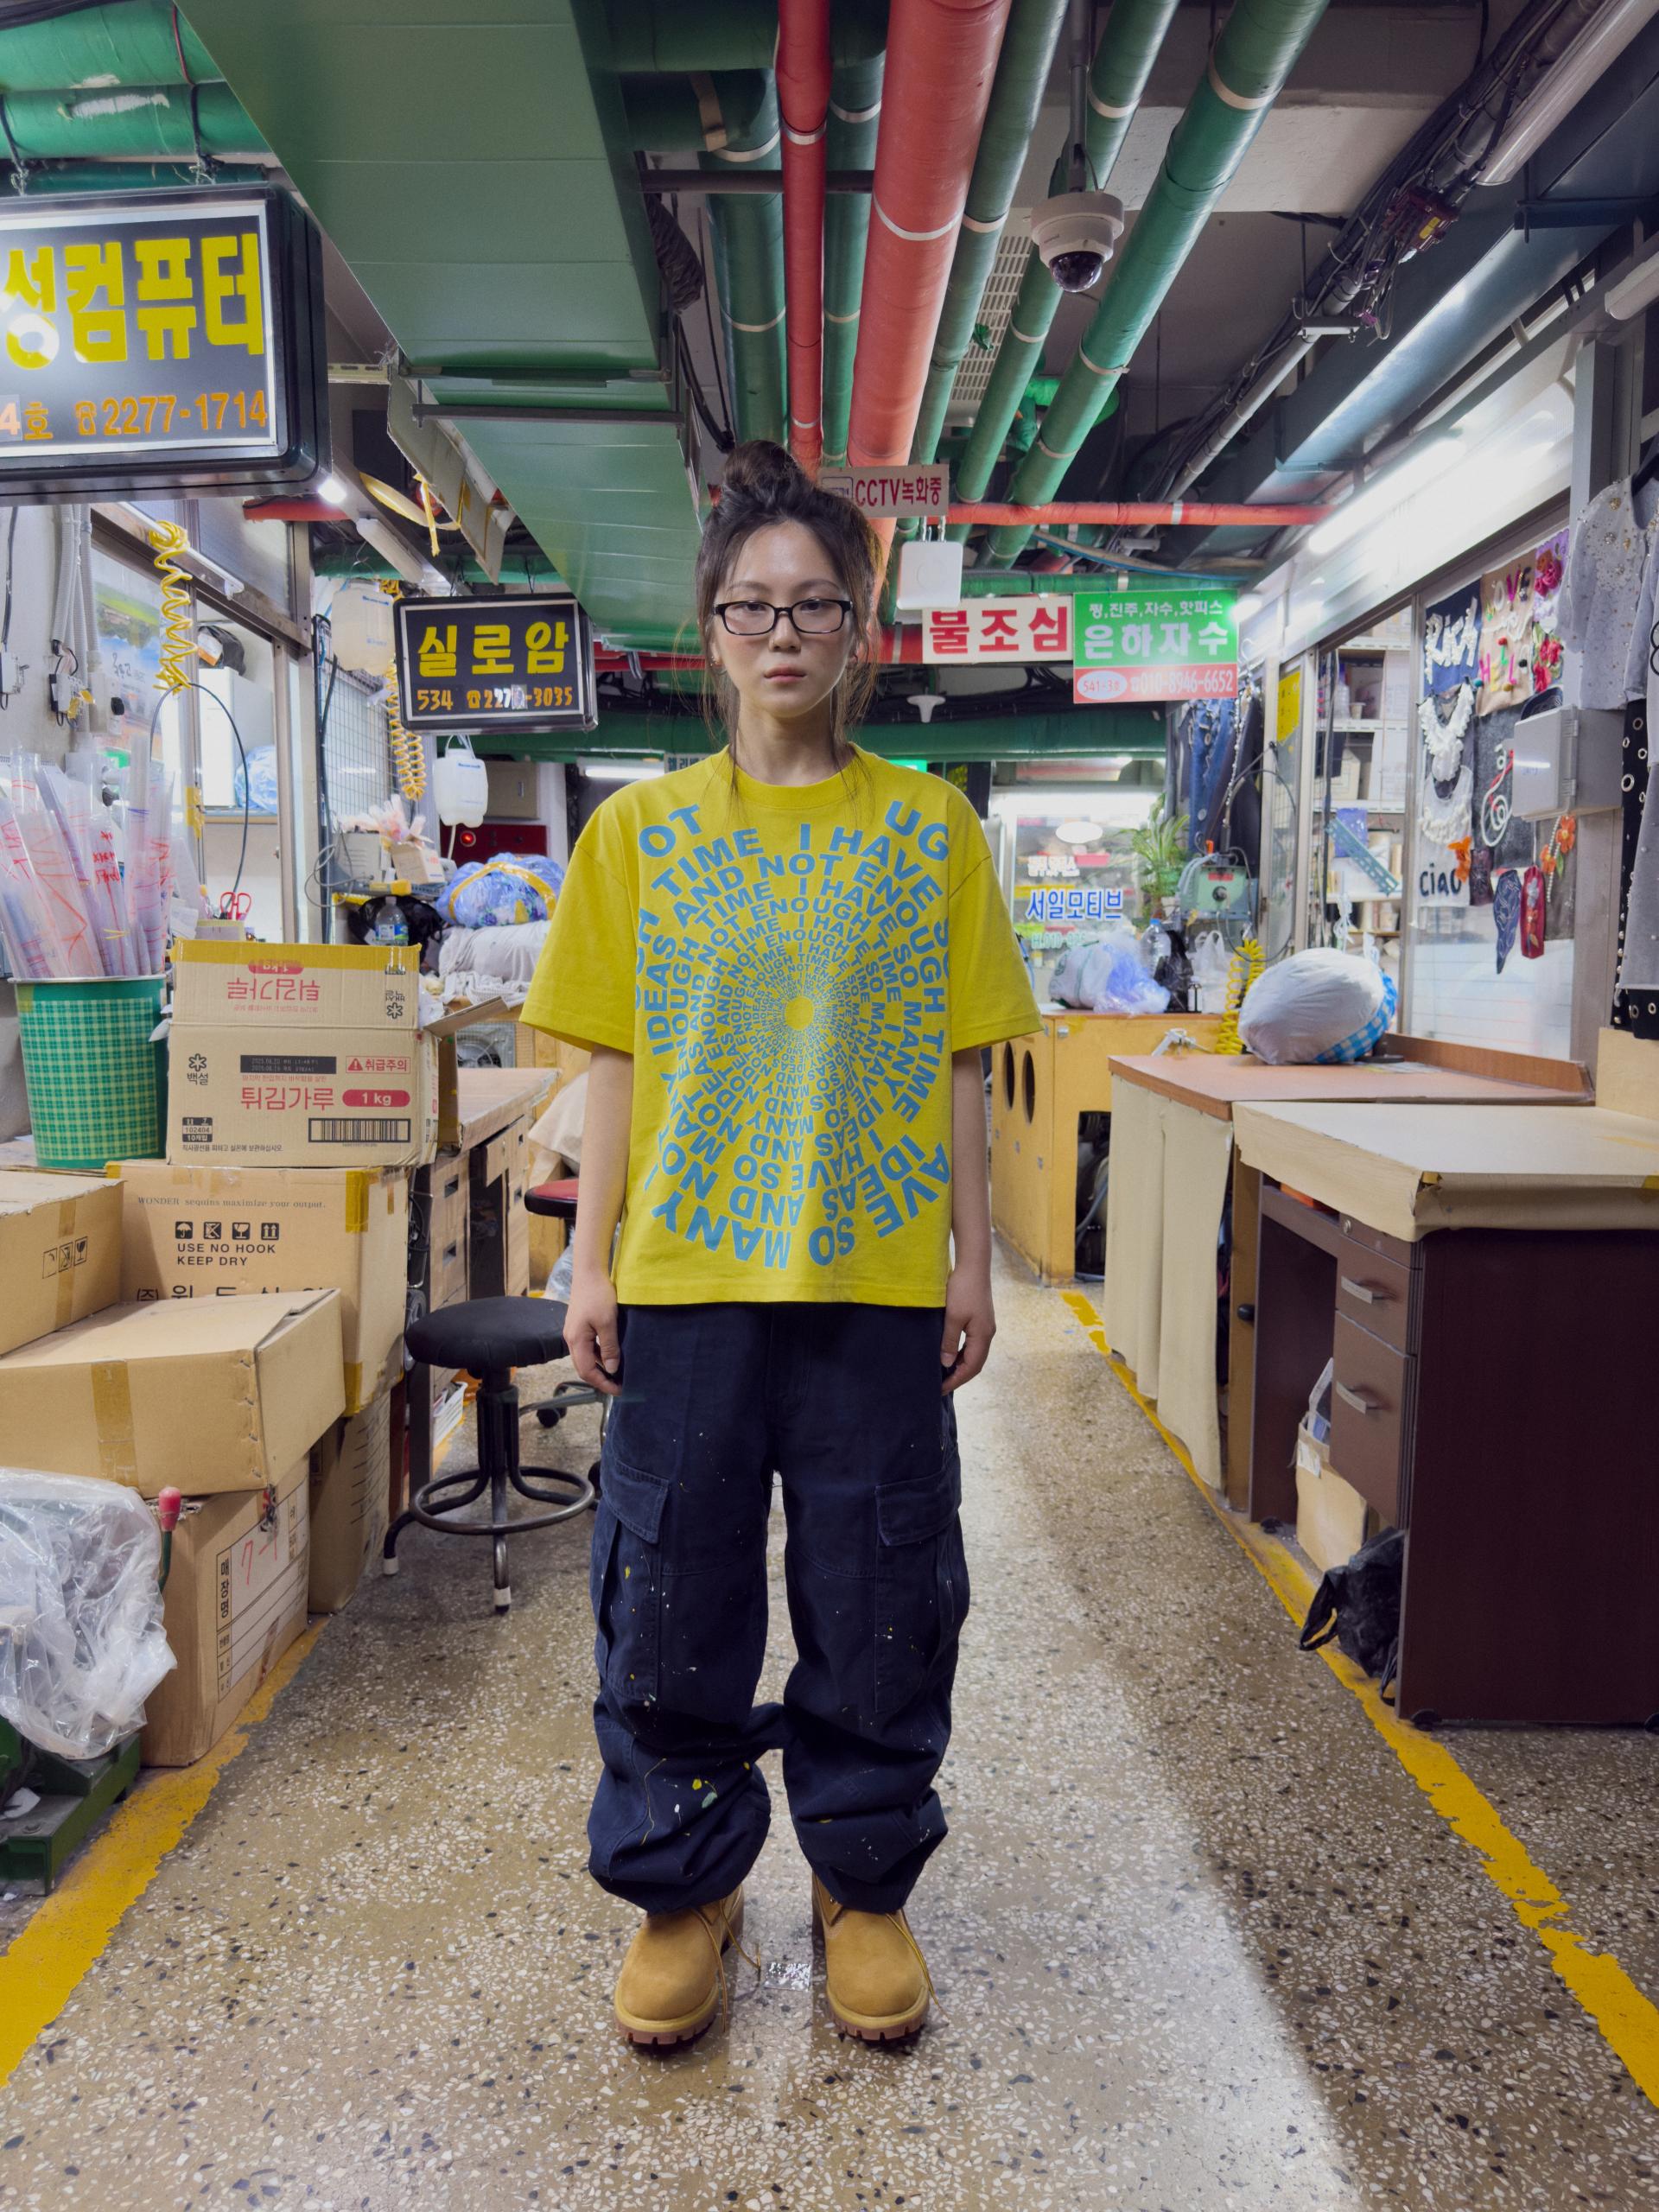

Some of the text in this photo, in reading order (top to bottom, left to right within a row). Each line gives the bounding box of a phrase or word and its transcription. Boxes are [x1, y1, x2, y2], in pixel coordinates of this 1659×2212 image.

[418, 621, 569, 677] 실로암
[929, 606, 1068, 654] 불조심
[1084, 621, 1229, 660] 은하자수
[417, 690, 453, 710] 534
[652, 829, 763, 896] TIME
[758, 854, 843, 878] NOT
[830, 827, 942, 911] HAVE
[673, 867, 744, 927] AND
[695, 881, 774, 929] TIME
[750, 897, 871, 932] ENOUGH
[820, 875, 899, 938] HAVE
[1027, 889, 1122, 919] 서일모티브
[698, 915, 741, 965] NOT
[725, 918, 781, 953] TIME
[814, 915, 874, 957] HAVE
[853, 861, 945, 1013] ENOUGH
[227, 977, 321, 1001] 튀김가루
[863, 961, 883, 993] SO
[873, 933, 901, 1001] TIME
[890, 944, 918, 988] SO
[645, 935, 678, 1055] IDEAS
[671, 937, 703, 1080] ENOUGH
[700, 957, 728, 1060] ENOUGH
[860, 1002, 885, 1070] MANY
[883, 1001, 921, 1097] MANY
[187, 1072, 209, 1086] 백설
[365, 1057, 408, 1071] 취급주의
[684, 1042, 743, 1116] IDEAS
[717, 1067, 760, 1103] NOT
[850, 1040, 896, 1107] HAVE
[892, 1030, 944, 1122] TIME
[241, 1087, 335, 1111] 튀김가루
[661, 1073, 725, 1165] MANY
[682, 1090, 742, 1142] NOT
[765, 1097, 804, 1116] AND
[825, 1103, 849, 1128] SO
[747, 1111, 813, 1136] MANY
[750, 1134, 804, 1161] AND
[815, 1096, 883, 1156] IDEAS
[734, 1154, 781, 1189] SO
[791, 1143, 864, 1191] HAVE
[823, 1135, 925, 1221] IDEAS
[138, 1197, 180, 1205] WONDER
[185, 1198, 219, 1207] sequins
[223, 1198, 267, 1207] maximize
[729, 1185, 804, 1226] AND
[178, 1243, 276, 1254] USE NO HOOK
[651, 1192, 791, 1268] MANY
[809, 1217, 855, 1266] SO
[178, 1256, 248, 1266] KEEP DRY
